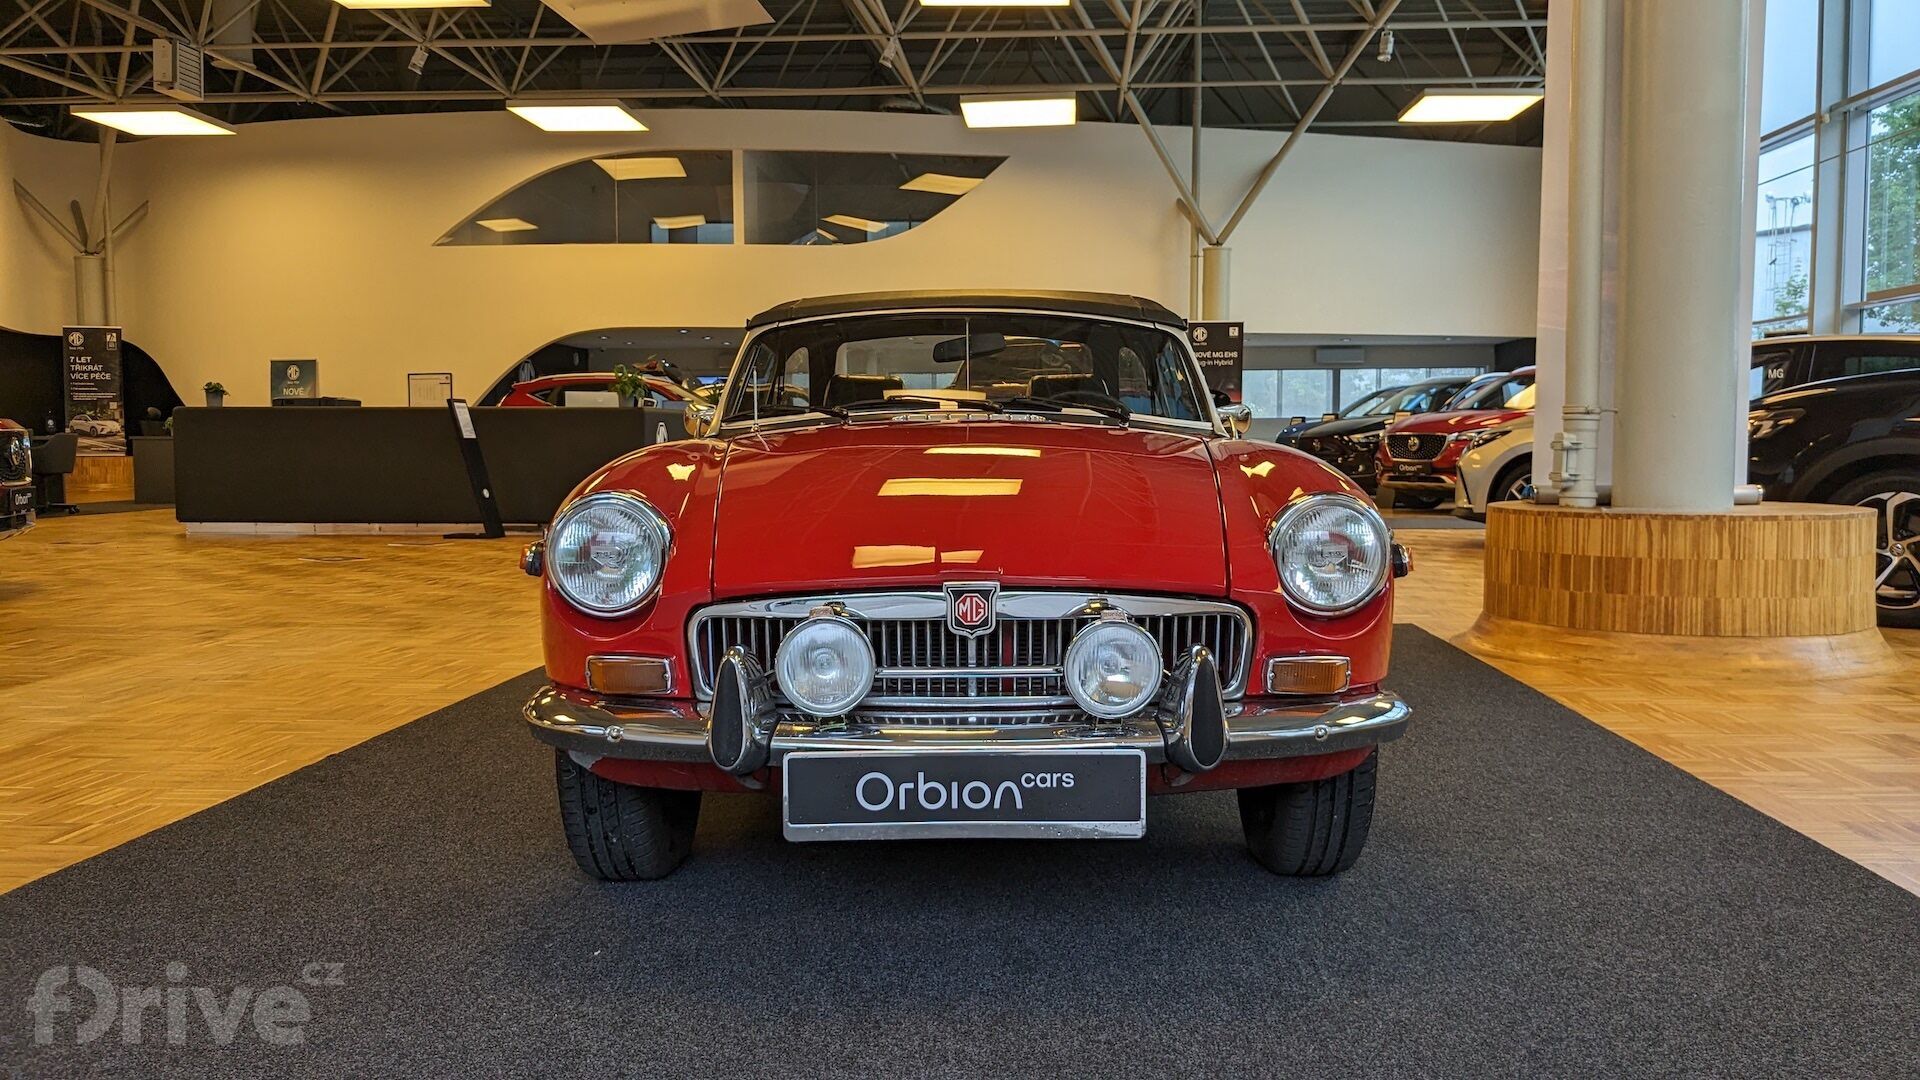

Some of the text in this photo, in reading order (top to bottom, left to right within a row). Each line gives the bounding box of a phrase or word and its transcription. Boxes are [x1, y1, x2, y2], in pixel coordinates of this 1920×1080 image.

[70, 372, 89, 380] VÍCE
[1767, 368, 1784, 379] MG
[283, 387, 304, 395] NOVÉ
[957, 595, 986, 623] MG
[855, 771, 1075, 812] Orbion cars
